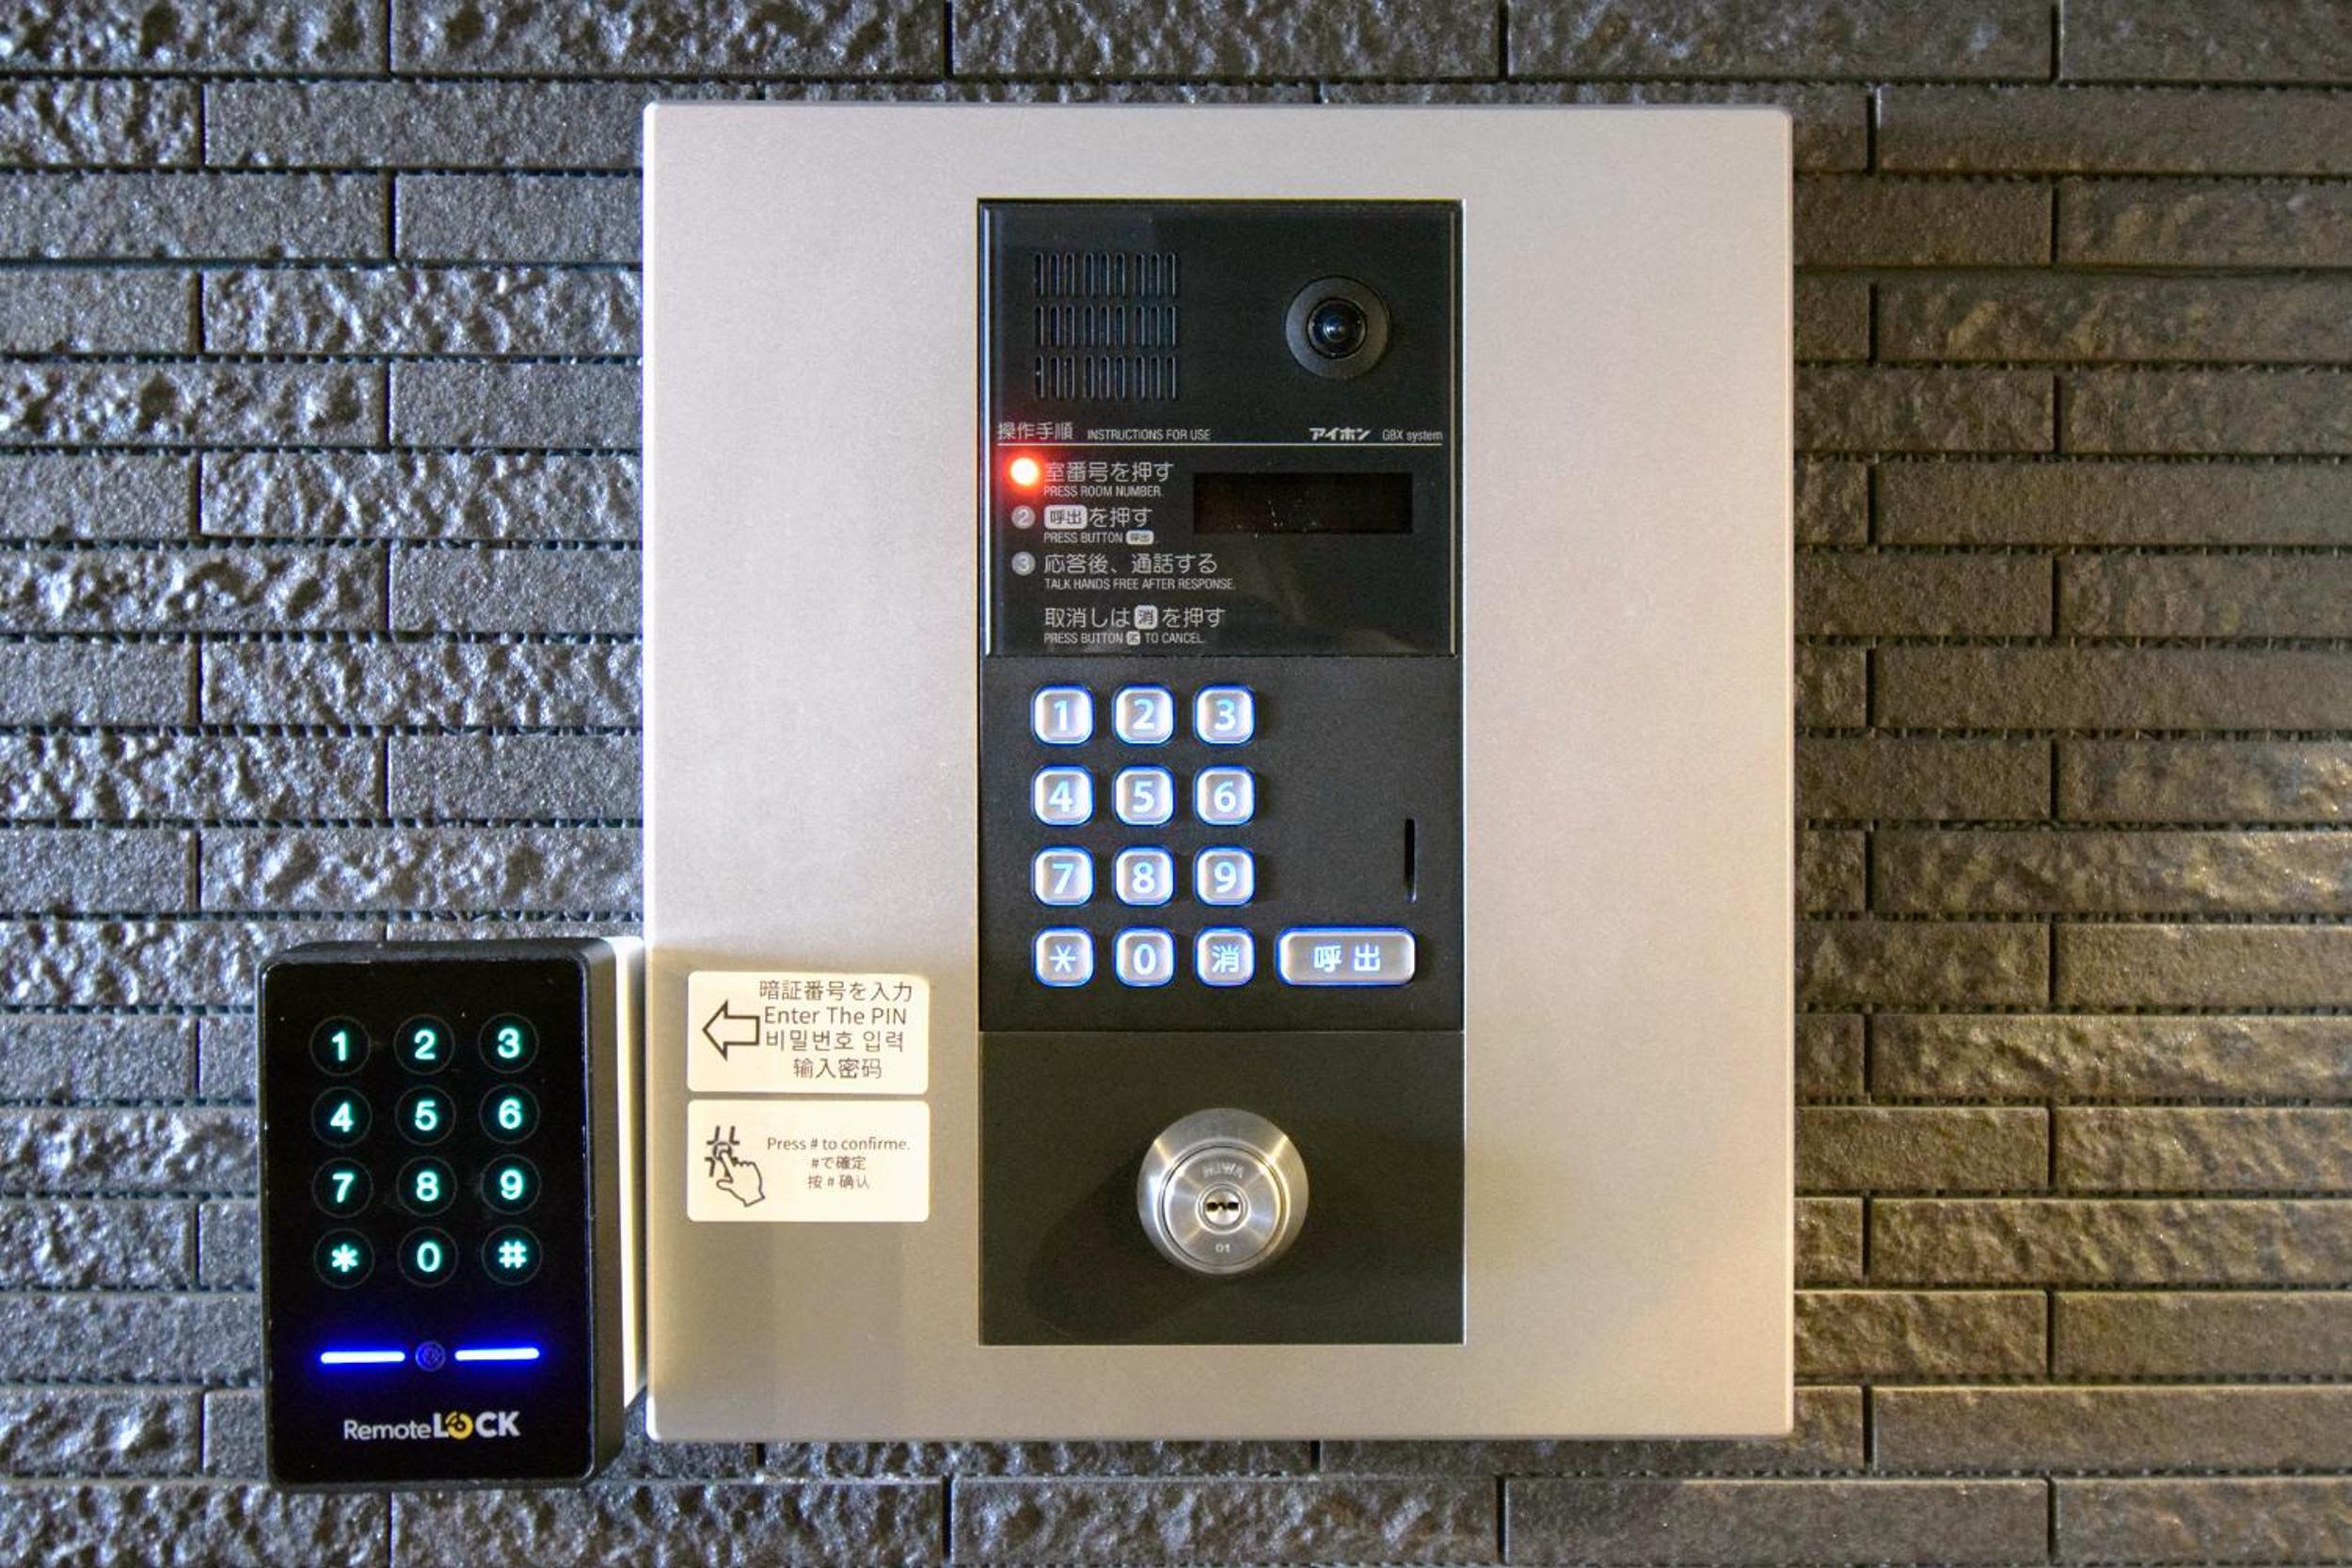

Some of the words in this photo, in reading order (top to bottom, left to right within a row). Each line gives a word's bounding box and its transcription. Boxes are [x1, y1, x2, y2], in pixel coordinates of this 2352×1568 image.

[998, 421, 1073, 440] 操作手順
[1088, 429, 1163, 441] INSTRUCTIONS
[1166, 429, 1186, 441] FOR
[1190, 429, 1211, 441] USE
[1309, 427, 1371, 441] アイホン
[1406, 430, 1443, 443] system
[1044, 462, 1173, 483] 室番号を押す
[1043, 485, 1077, 497] PRESS
[1080, 485, 1113, 497] ROOM
[1043, 532, 1077, 543] PRESS
[1081, 532, 1123, 543] BUTTON
[1045, 578, 1072, 590] TALK
[1073, 578, 1110, 590] HANDS
[1113, 578, 1139, 590] FREE
[1142, 578, 1175, 590] AFTER
[1043, 632, 1077, 643] PRESS
[1081, 632, 1123, 643] BUTTON
[1144, 632, 1159, 643] TO
[1054, 700, 1068, 731] 1
[1132, 699, 1155, 730] 2
[1215, 699, 1236, 731] 3
[1048, 781, 1073, 813] 4
[1133, 781, 1155, 813] 5
[1214, 781, 1236, 813] 6
[1053, 863, 1073, 894] 7
[1132, 862, 1155, 894] 8
[1214, 862, 1236, 894] 9
[1133, 943, 1156, 974] 0
[1211, 945, 1239, 974] 消
[759, 979, 913, 1003] 暗証番号を入力
[764, 1006, 820, 1024] Enter
[826, 1006, 865, 1024] The
[871, 1007, 907, 1025] PIN
[331, 1030, 348, 1062] 1
[414, 1029, 437, 1060] 2
[498, 1027, 521, 1059] 3
[766, 1029, 853, 1052] 비밀번호
[863, 1030, 903, 1053] 입력
[793, 1057, 882, 1079] 输入密码
[330, 1101, 354, 1132] 4
[415, 1101, 437, 1132] 5
[499, 1099, 522, 1130] 6
[767, 1136, 807, 1150] Press
[810, 1137, 818, 1149] #
[822, 1137, 837, 1150] to
[840, 1136, 911, 1150] confirme.
[811, 1155, 866, 1170] #で確定
[332, 1172, 355, 1204] 7
[416, 1171, 439, 1202] 8
[501, 1169, 523, 1200] 9
[417, 1241, 441, 1273] 0
[499, 1241, 527, 1269] #
[343, 1411, 520, 1440] RemoteLOCK
